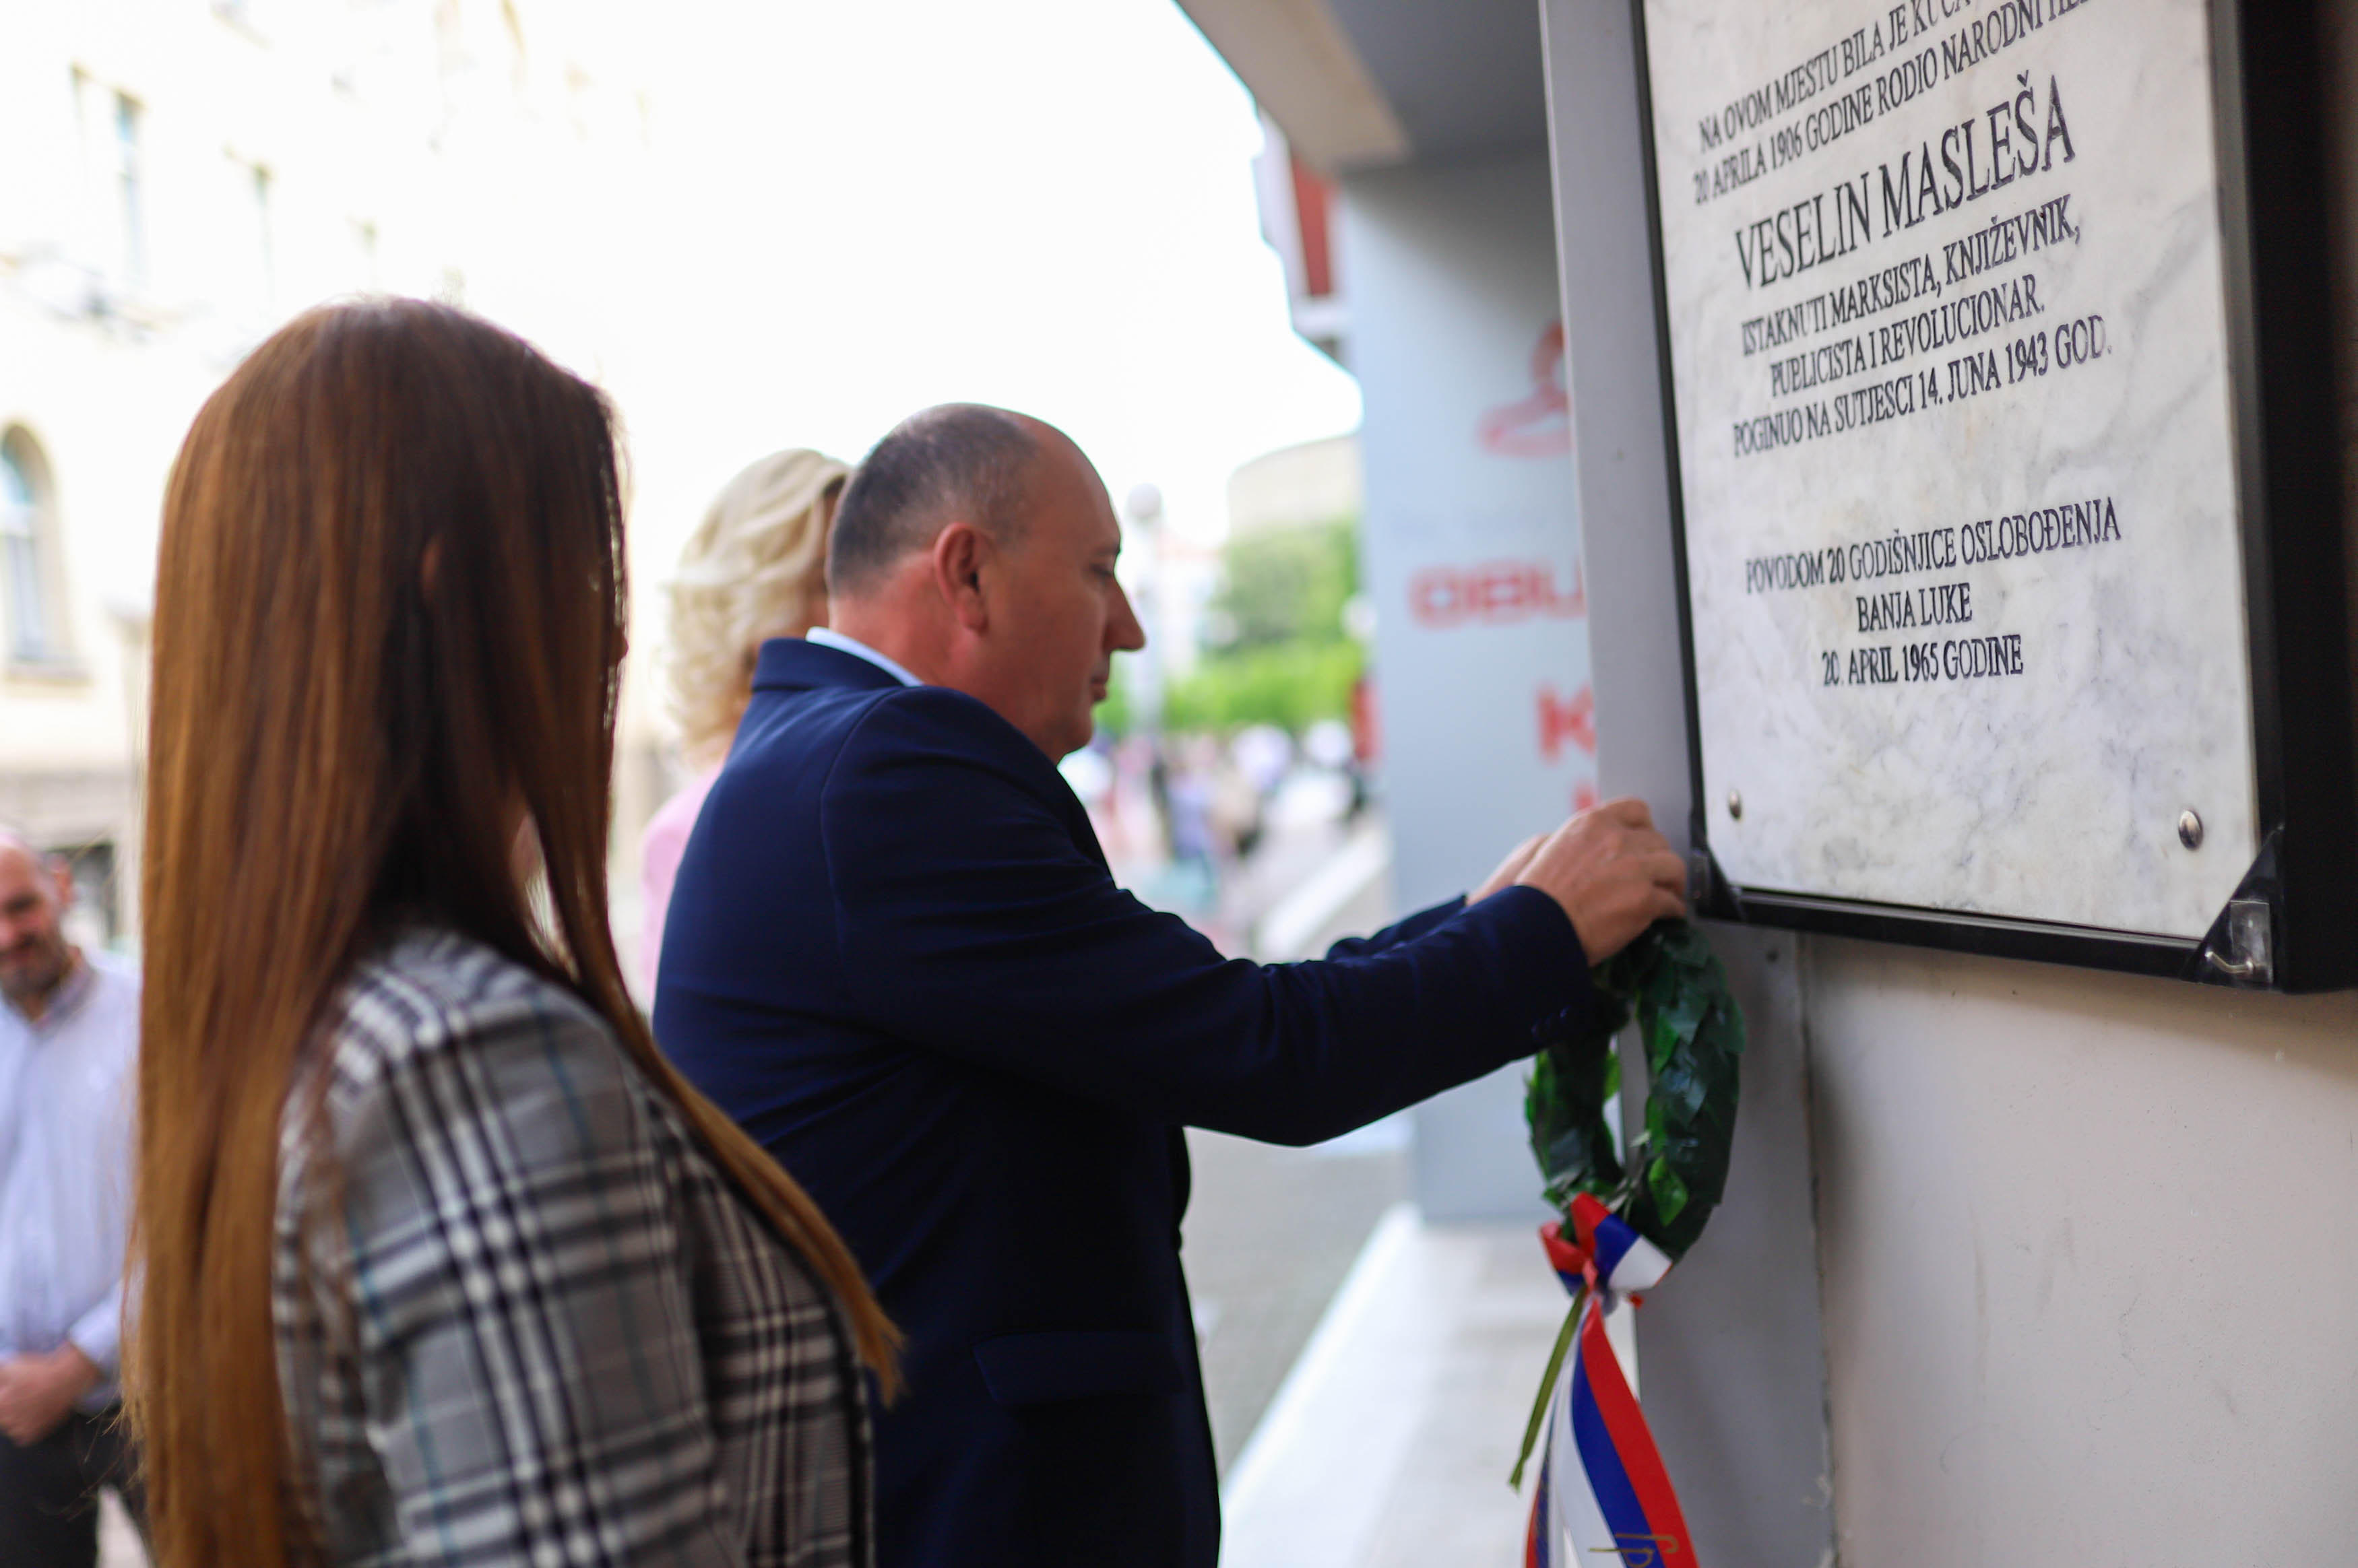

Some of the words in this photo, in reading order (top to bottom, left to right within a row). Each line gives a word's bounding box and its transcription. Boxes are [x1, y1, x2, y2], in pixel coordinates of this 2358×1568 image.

[1699, 112, 1723, 154] NA
[1723, 83, 1773, 139] OVOM
[1775, 45, 1838, 113] MJESTU
[1841, 20, 1885, 78] BILA
[1889, 3, 1908, 51] JE
[1713, 141, 1767, 197] APRILA
[1771, 120, 1803, 170] 1906
[1806, 84, 1874, 152] GODINE
[1876, 48, 1938, 116] RODIO
[1941, 0, 2043, 80] NARODNI
[1736, 172, 1871, 290] VESELIN
[1881, 70, 2076, 238] MASLEŠA
[1742, 294, 1827, 356] ISTAKNUTI
[1830, 254, 1941, 327] MARKSISTA,
[1943, 194, 2080, 286] KNJIŽEVNIK,
[1770, 335, 1866, 397] PUBLICISTA
[1869, 331, 1878, 368] I
[1880, 274, 2045, 365] REVOLUCIONAR.
[1733, 407, 1802, 457] POGINUO
[1806, 400, 1831, 440] NA
[1835, 375, 1915, 432] SUTJESCI
[1919, 367, 1942, 409] 14.
[1948, 349, 2001, 402] JUNA
[2006, 331, 2049, 384] 1943
[2055, 315, 2112, 369] GOD.
[1746, 548, 1824, 595] POVODOM
[1828, 546, 1845, 584] 20
[1850, 528, 1956, 581] GODIŠNJICE
[1961, 496, 2121, 564] OSLOBOĐENJA
[1857, 590, 1916, 632] BANJA
[1919, 583, 1973, 625] LUKE
[1849, 647, 1899, 684] APRIL
[1903, 643, 1938, 682] 1965
[1944, 634, 2022, 680] GODINE
